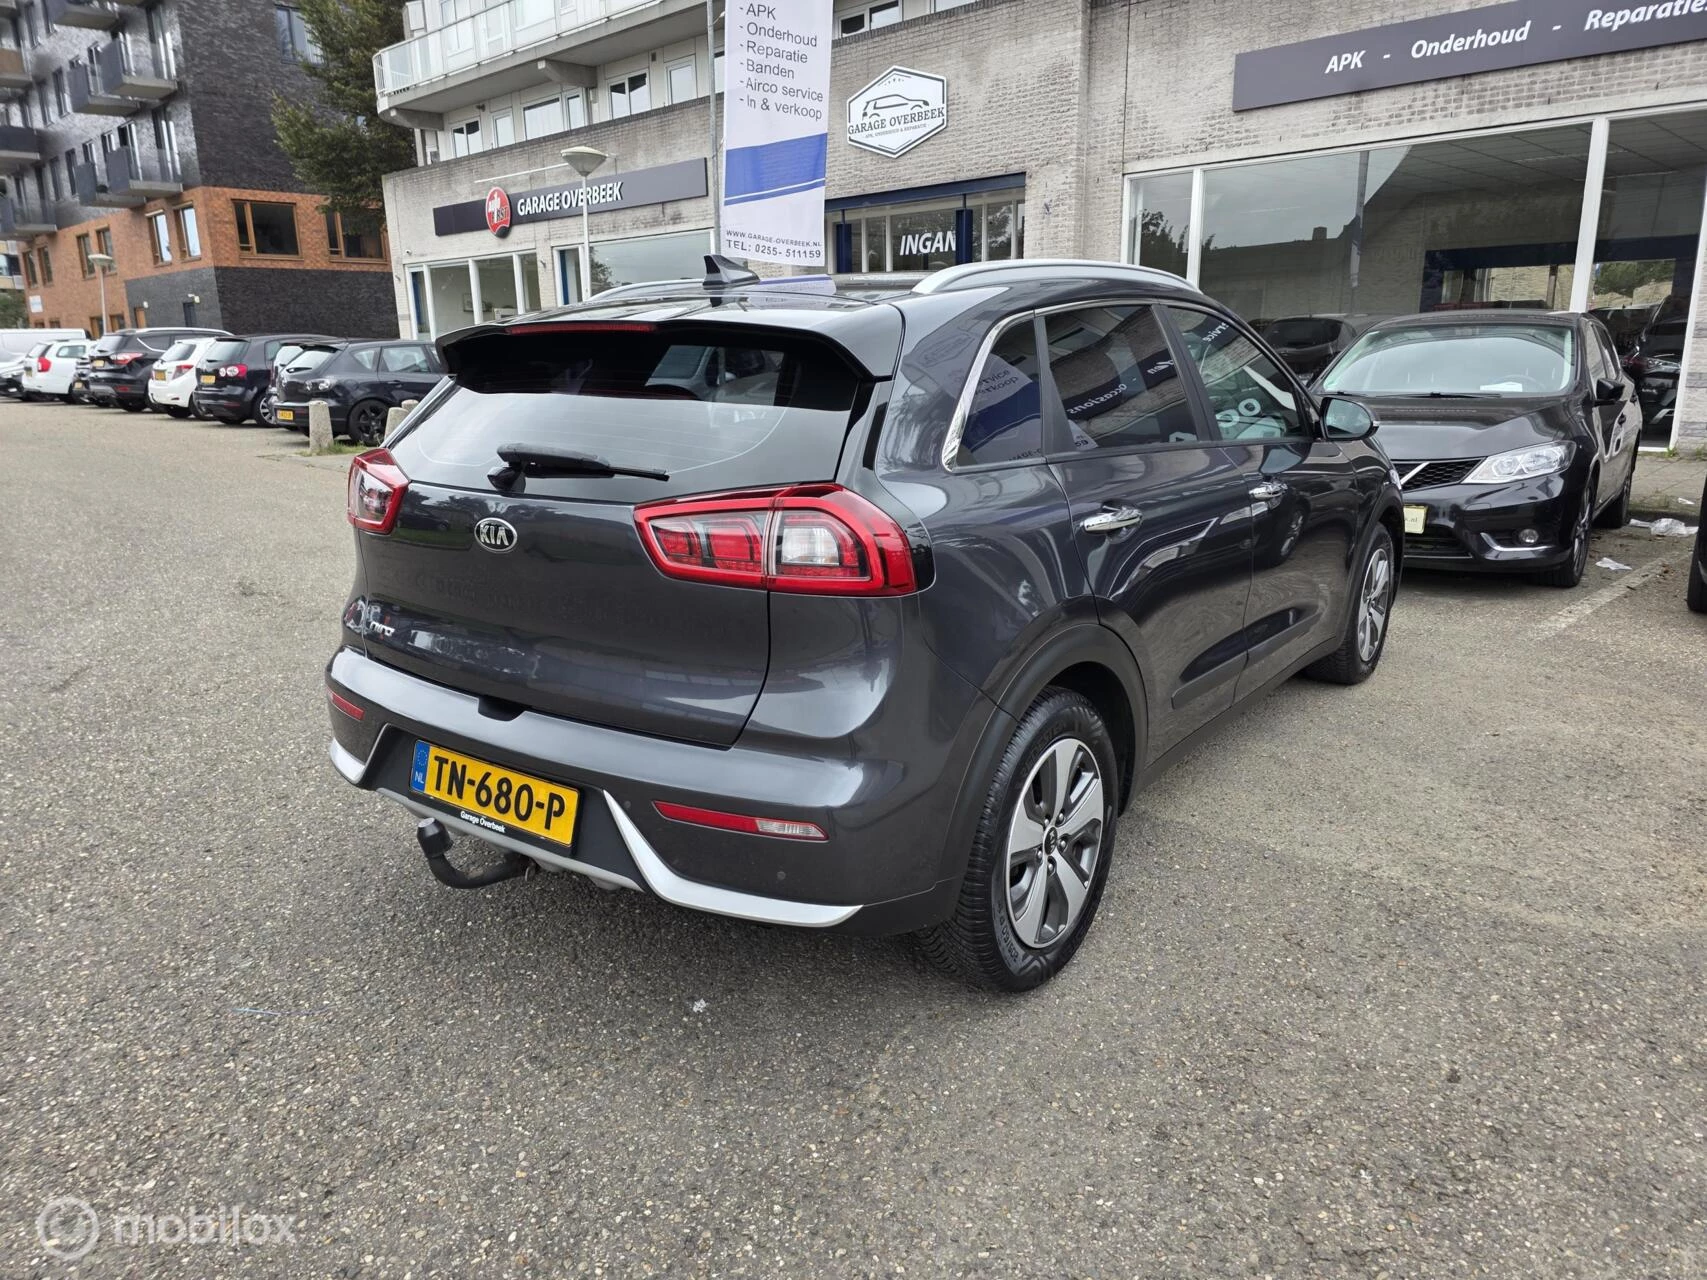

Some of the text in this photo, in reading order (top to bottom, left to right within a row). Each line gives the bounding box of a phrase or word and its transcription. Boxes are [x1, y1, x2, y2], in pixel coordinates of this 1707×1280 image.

[746, 3, 776, 20] APK
[746, 22, 817, 47] Onderhoud
[746, 40, 808, 63] Reparatie
[1324, 50, 1366, 74] APK
[1410, 20, 1532, 59] Onderhoud
[746, 59, 794, 79] Banden
[746, 77, 778, 94] Airco
[781, 85, 824, 102] service
[747, 95, 756, 109] In
[760, 97, 770, 111] &
[775, 102, 822, 122] verkoop
[848, 107, 945, 135] GARAGE OVERBEEK
[517, 193, 561, 215] GARAGE
[726, 239, 821, 259] TEL: 0255- 511159
[479, 522, 509, 546] KIA
[414, 755, 566, 831] NL TN-680-P
[460, 810, 506, 833] Garage Overbeek
